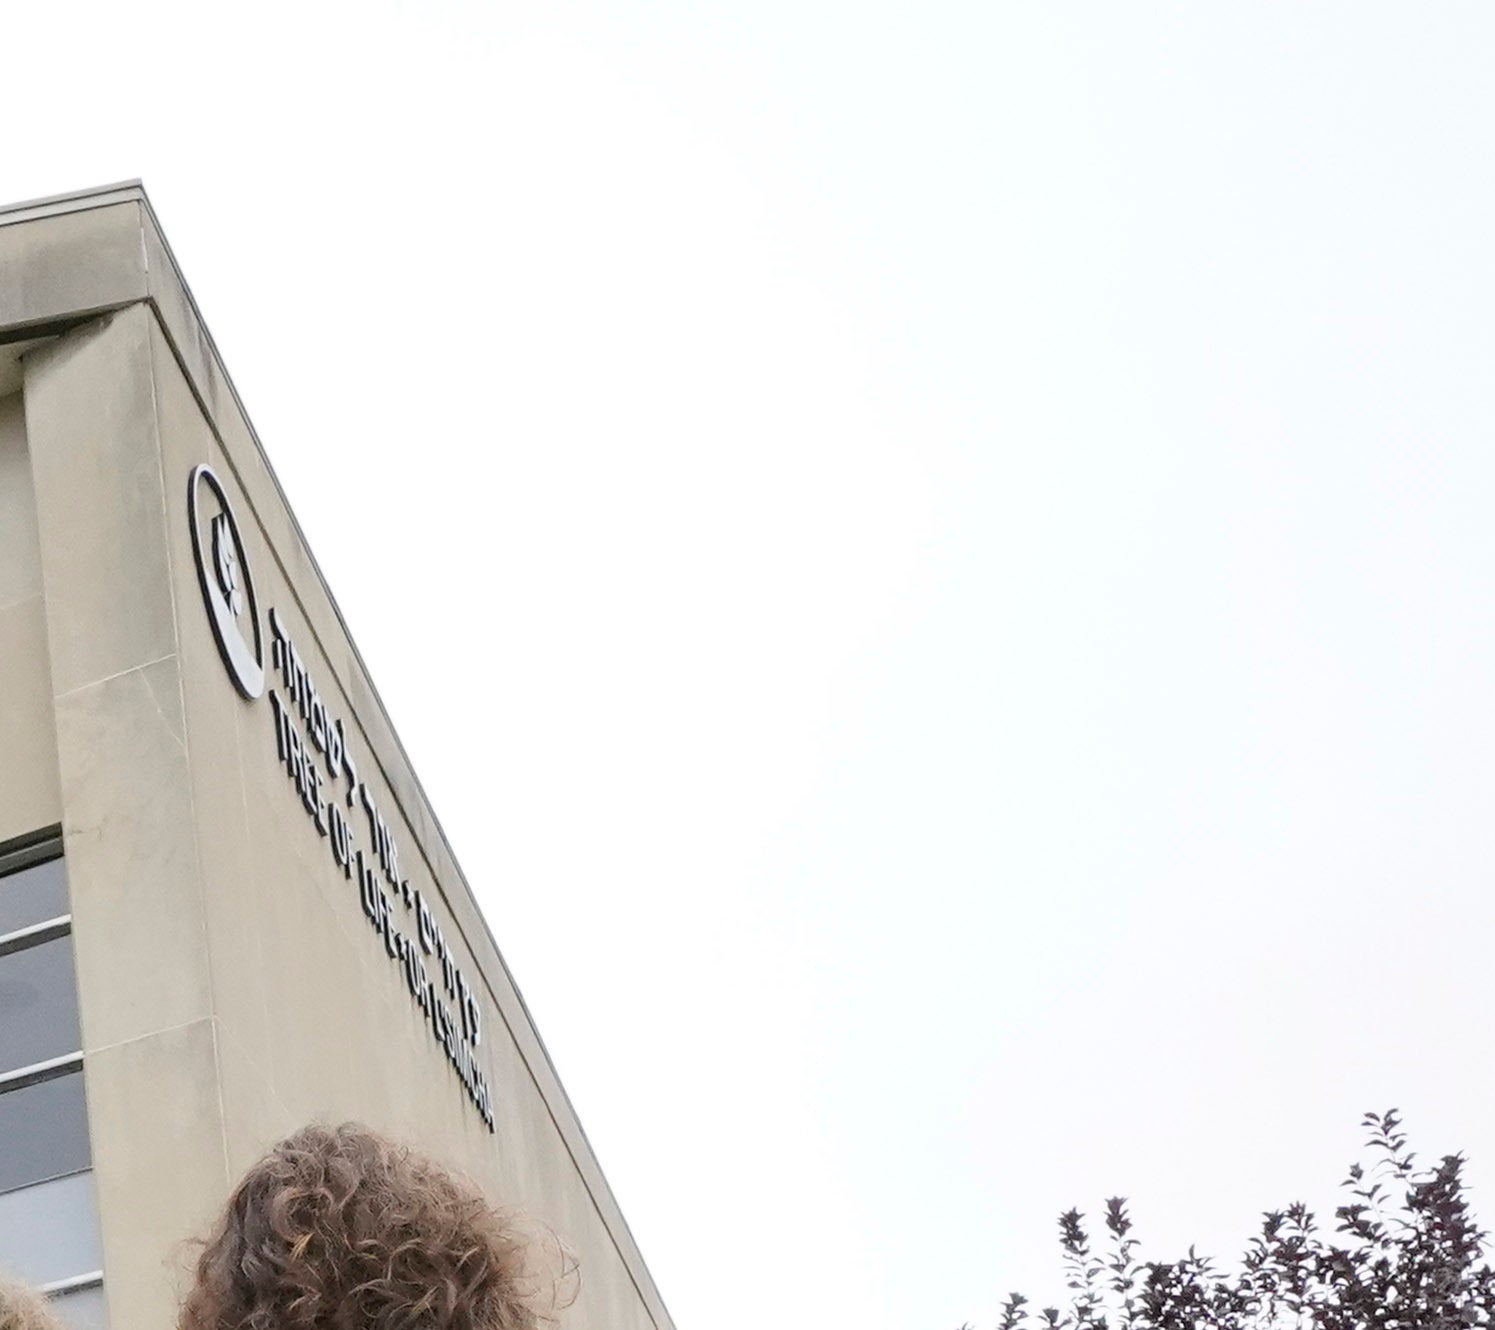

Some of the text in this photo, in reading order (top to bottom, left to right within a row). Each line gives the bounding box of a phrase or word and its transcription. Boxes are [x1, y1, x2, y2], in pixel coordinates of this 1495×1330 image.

[268, 606, 481, 1047] עץ חיים אור לשמחה
[268, 688, 328, 838] TREE
[327, 801, 357, 881] OF
[356, 849, 398, 960] LIFE
[404, 937, 431, 1018] OR
